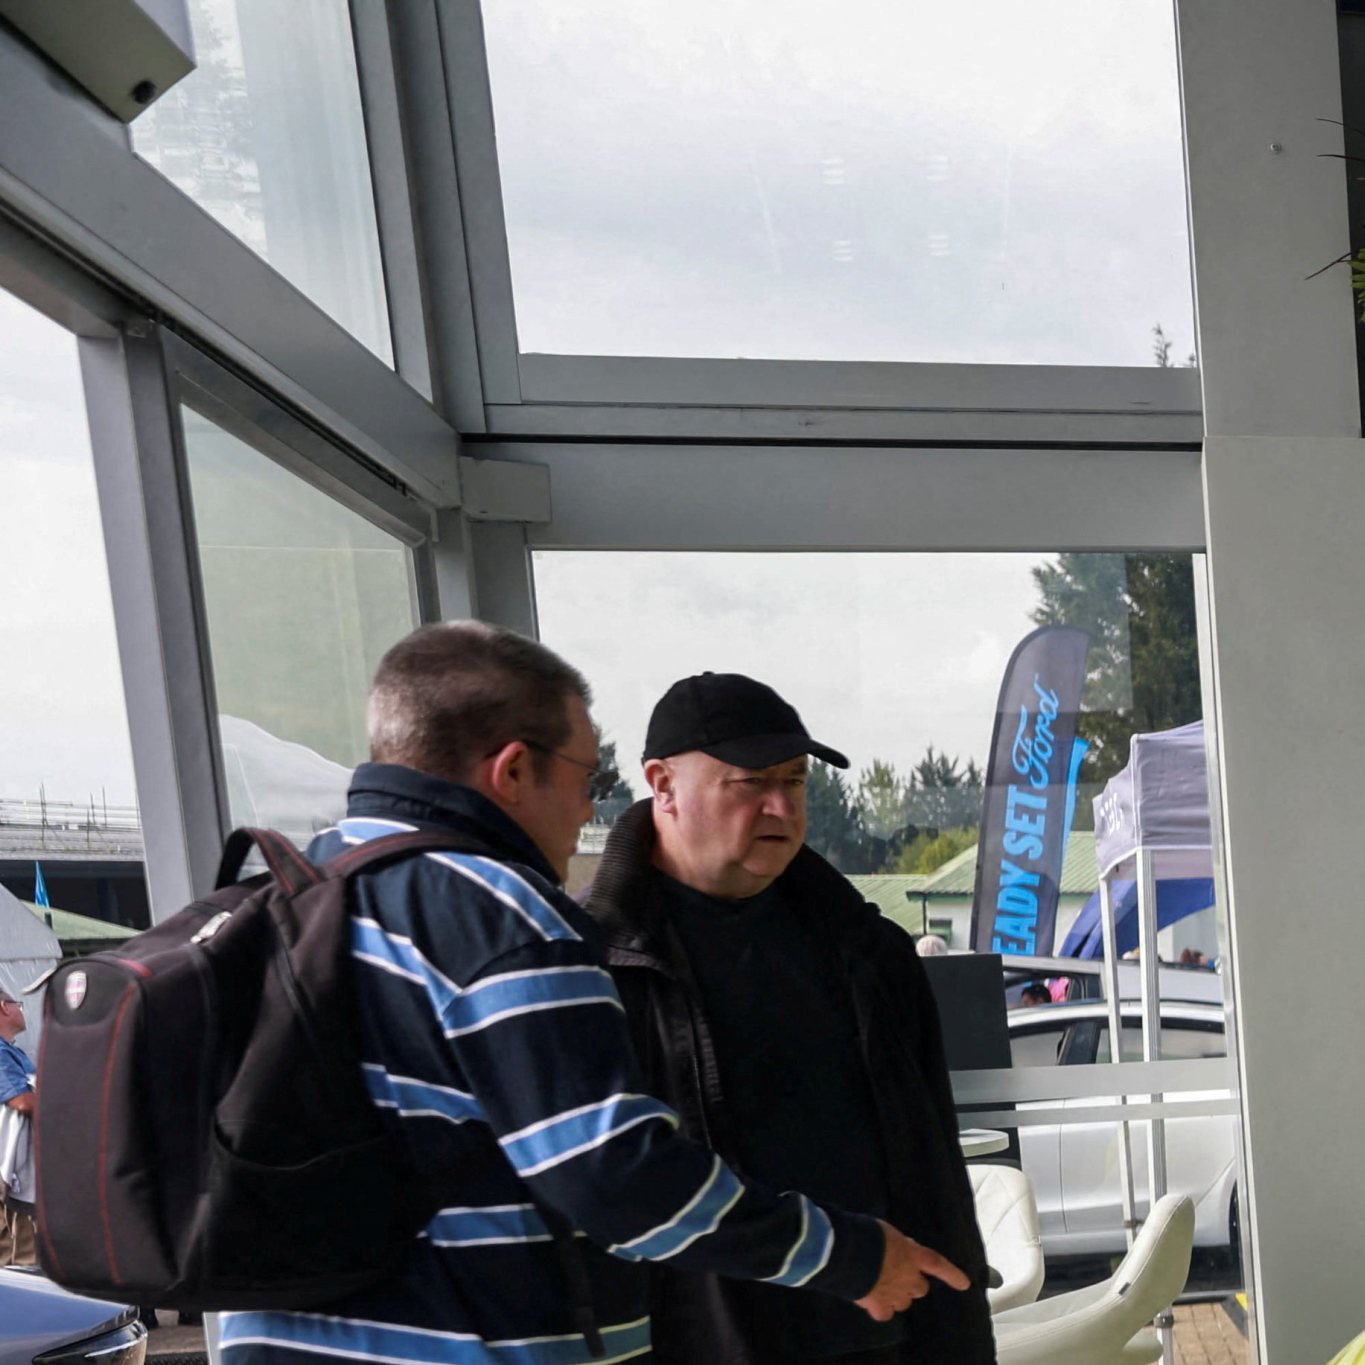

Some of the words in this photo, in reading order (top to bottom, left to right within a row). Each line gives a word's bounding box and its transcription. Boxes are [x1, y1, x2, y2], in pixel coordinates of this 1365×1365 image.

[1012, 672, 1059, 791] Ford
[1003, 783, 1047, 861] SET
[992, 862, 1044, 956] EADY
